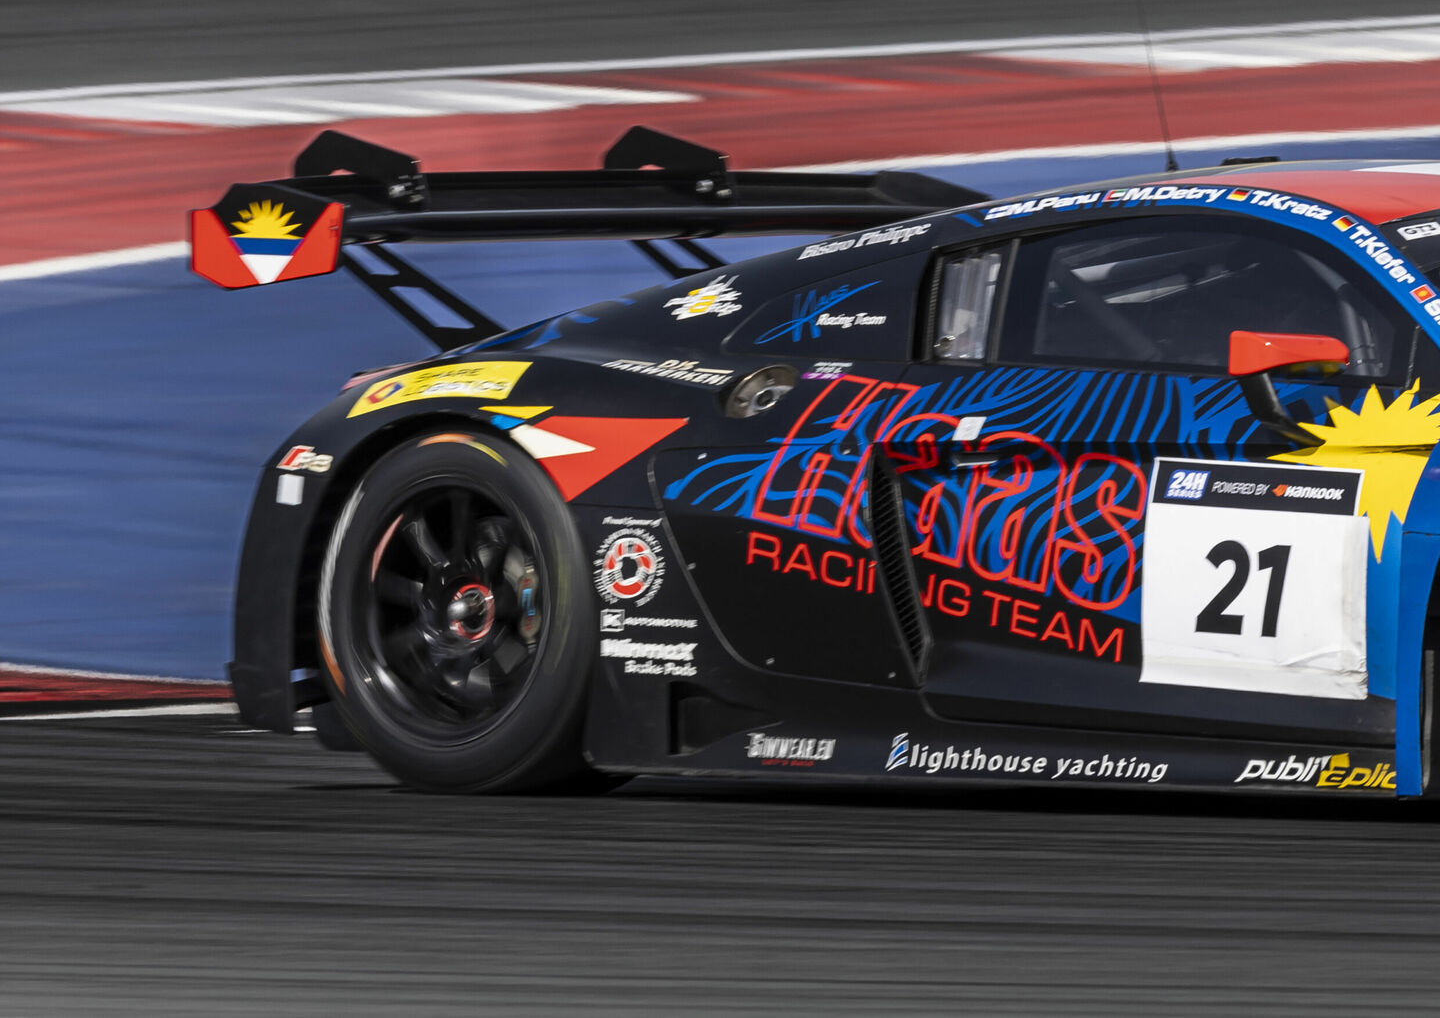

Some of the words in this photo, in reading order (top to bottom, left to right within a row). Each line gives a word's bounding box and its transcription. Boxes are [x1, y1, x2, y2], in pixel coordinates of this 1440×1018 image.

[1124, 186, 1226, 203] M.Detry
[1249, 189, 1334, 221] T.Kratz
[796, 239, 856, 260] Bistro
[853, 223, 932, 248] Philippe
[1349, 225, 1416, 284] T.Kiefer
[816, 313, 855, 329] Racing
[853, 312, 887, 325] Team
[1168, 471, 1209, 490] 24H
[1211, 481, 1256, 495] POWERED
[1254, 483, 1272, 497] BY
[1194, 539, 1292, 638] 21
[982, 589, 1124, 663] TEAM
[624, 660, 664, 675] Brake
[663, 662, 698, 676] Pads
[909, 744, 1048, 774] lighthouse
[1051, 754, 1169, 782] yachting
